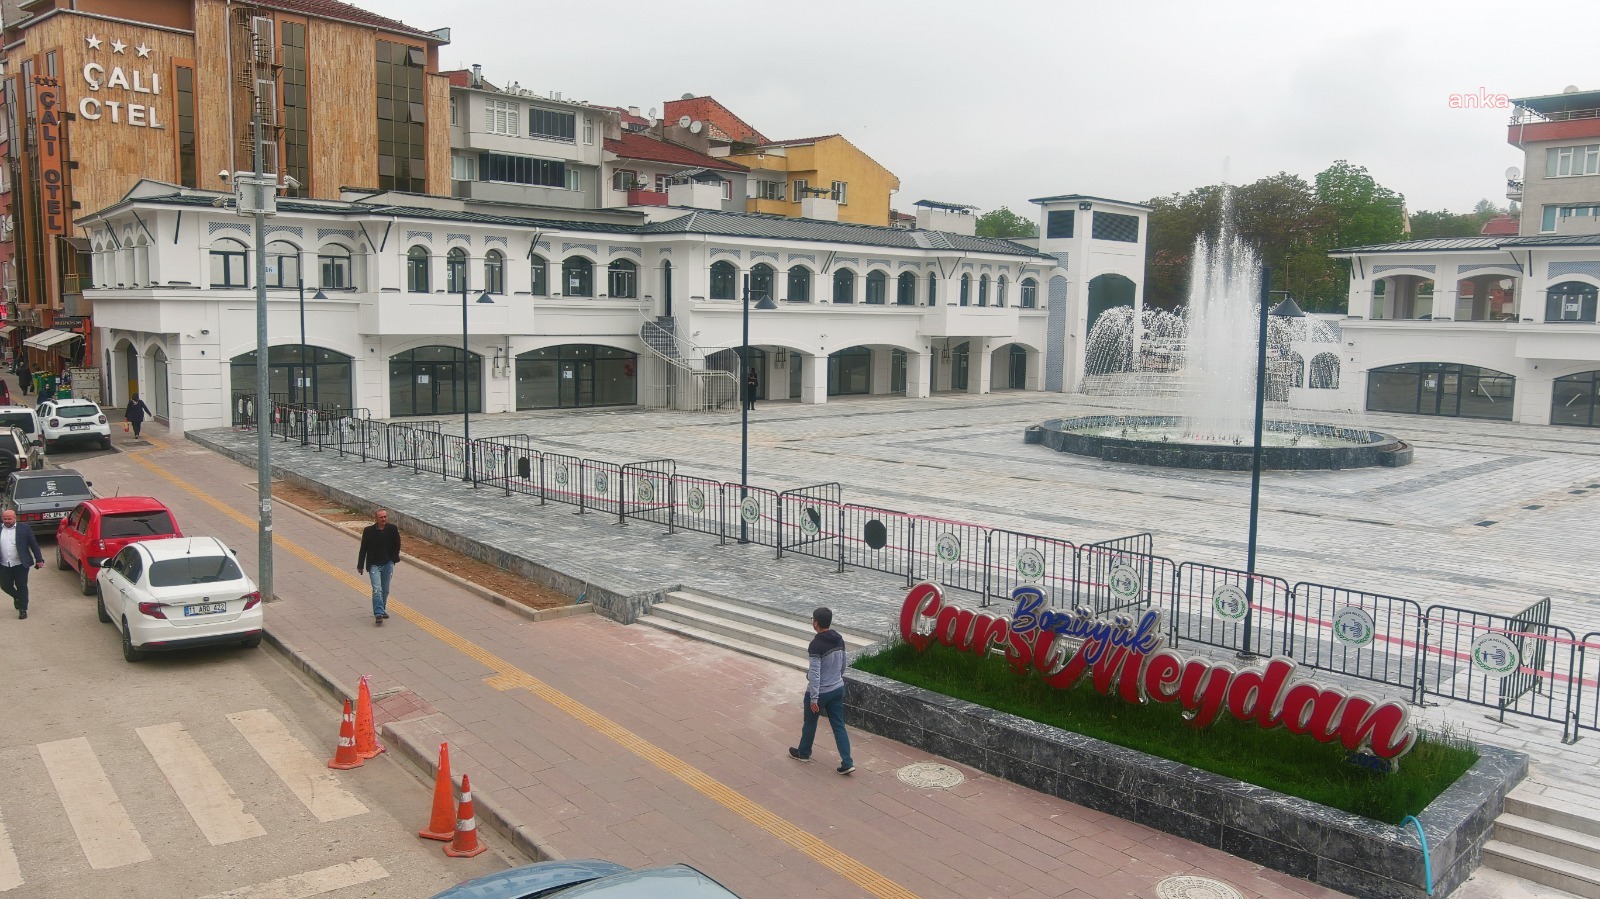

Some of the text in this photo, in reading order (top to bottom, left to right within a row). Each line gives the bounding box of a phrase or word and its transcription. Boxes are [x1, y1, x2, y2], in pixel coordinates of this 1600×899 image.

[79, 97, 166, 130] OTEL
[83, 62, 160, 95] ÇALI
[40, 91, 61, 230] ÇALI OTEL
[1010, 583, 1166, 664] Bozüyük
[1043, 634, 1420, 759] Meydan
